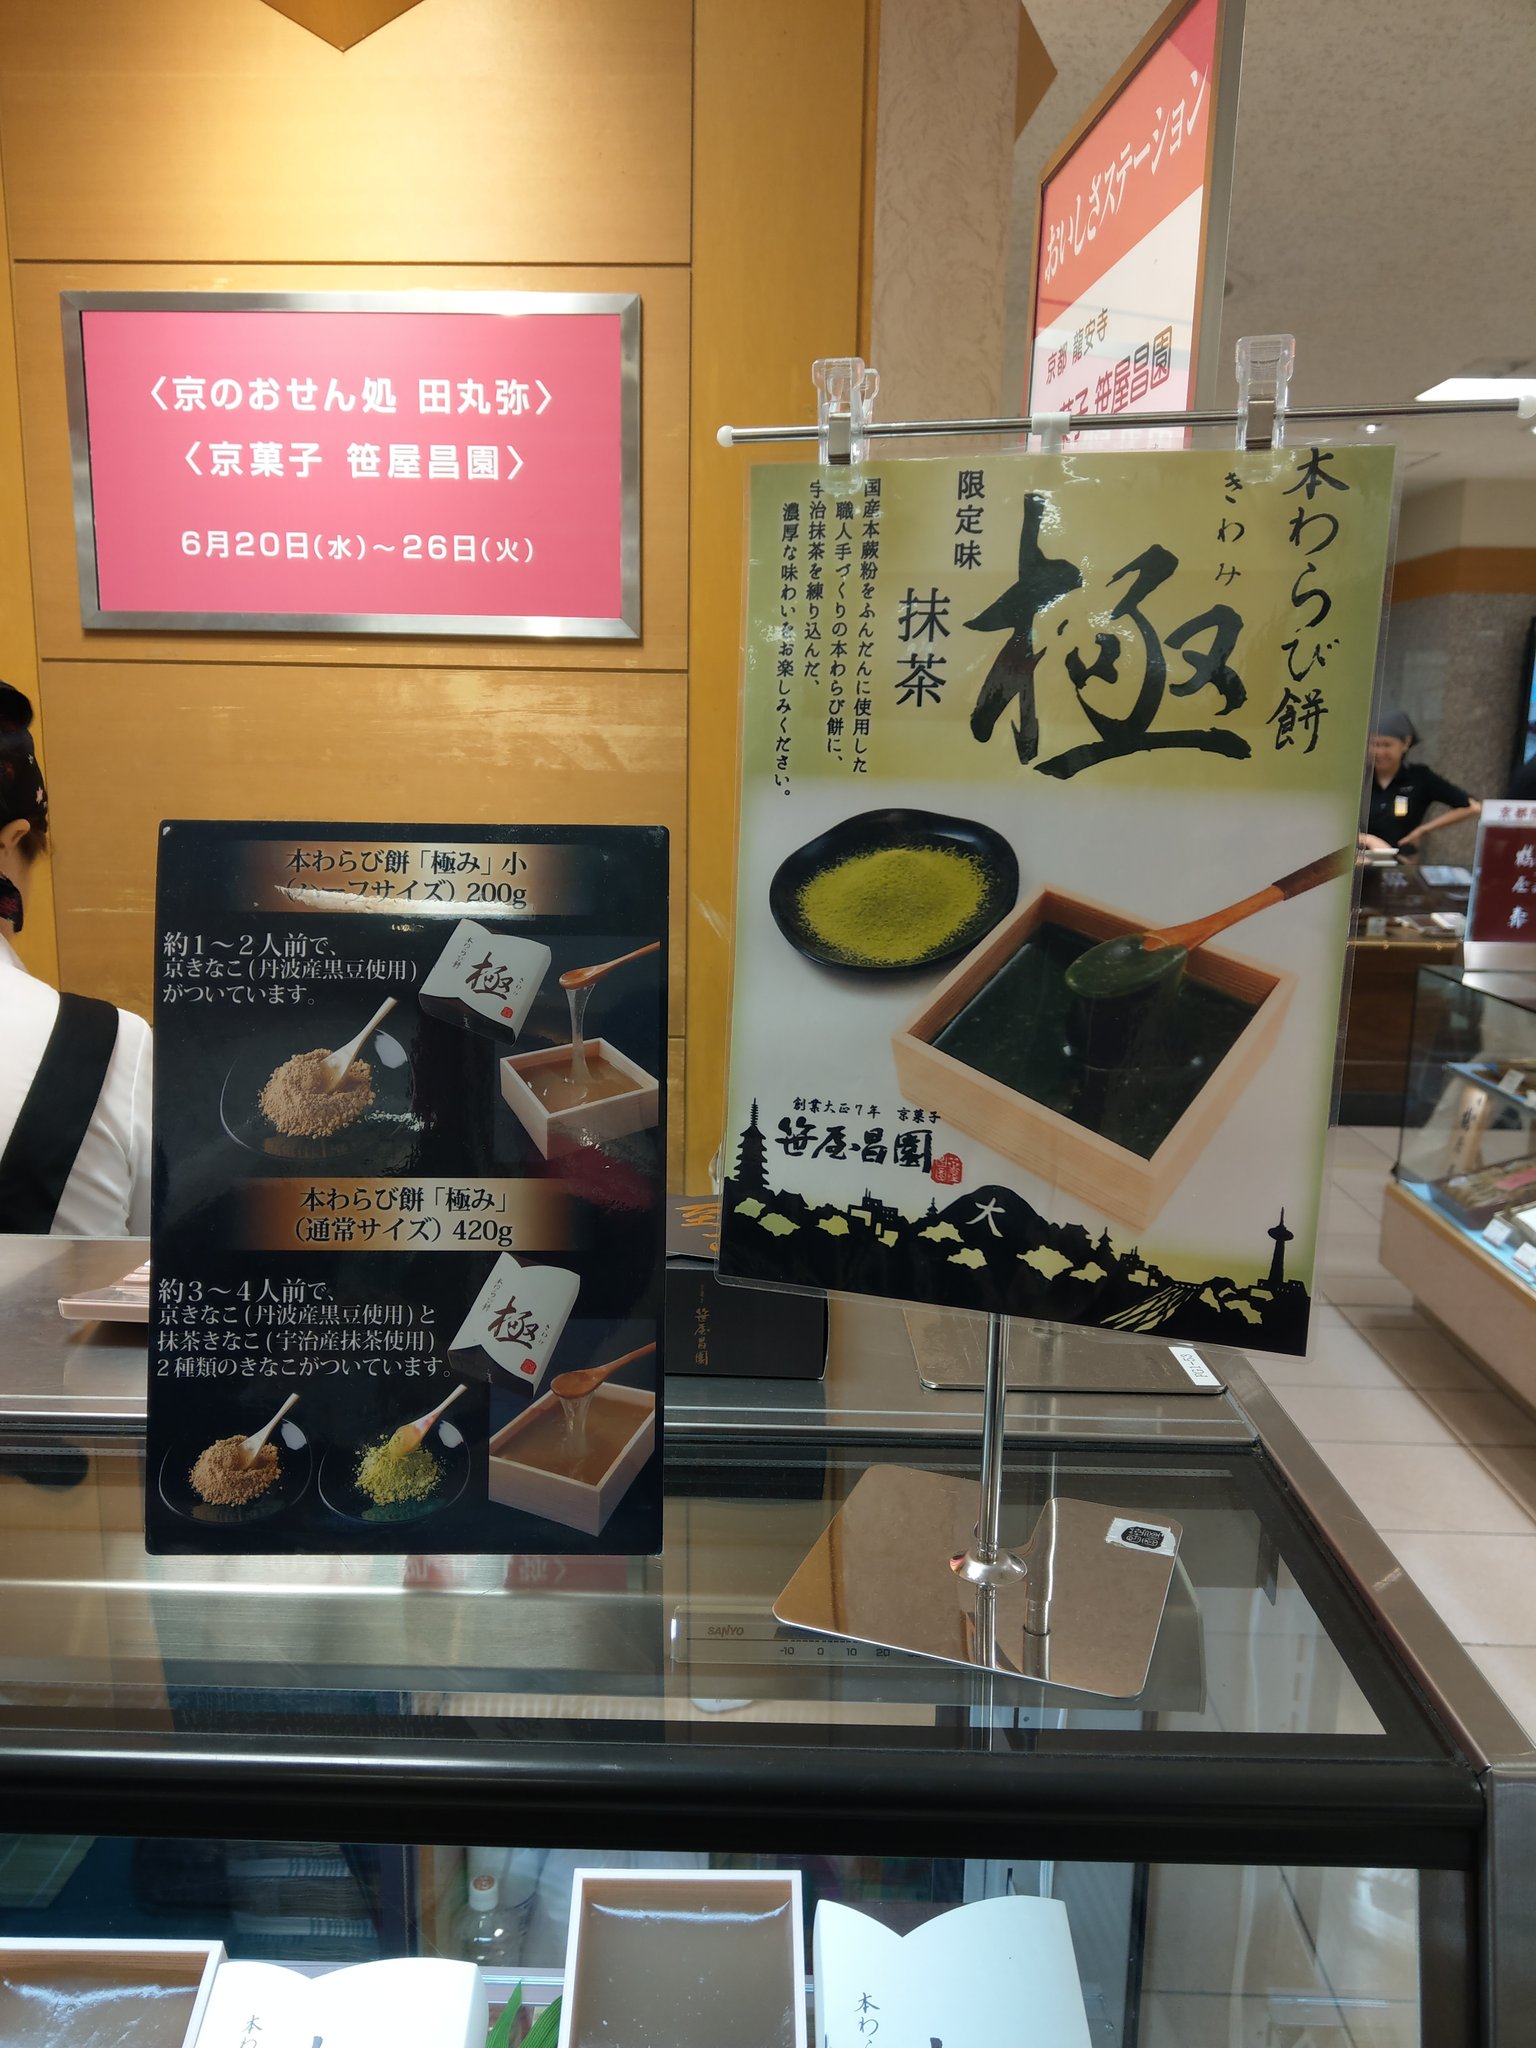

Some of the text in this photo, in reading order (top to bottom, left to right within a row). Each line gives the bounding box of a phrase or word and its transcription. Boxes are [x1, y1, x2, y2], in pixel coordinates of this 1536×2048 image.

[1044, 63, 1209, 285] おいしさステーション
[1046, 308, 1108, 384] 京都 龍安寺
[1095, 325, 1173, 415] 笹屋昌園
[953, 469, 986, 570] 限定味
[1214, 470, 1246, 587] きわみ
[827, 501, 854, 762] 職人手づくりの本わらび餅に、
[852, 478, 882, 773] 国産本蕨粉をふんだんに使用した
[894, 588, 951, 708] 抹茶
[962, 491, 1253, 780] 極
[1265, 447, 1352, 755] 本わらび餅
[163, 984, 315, 1006] がついています。
[465, 951, 514, 1000] 極
[792, 1096, 941, 1124] 創業大正7年 京菓子
[299, 1186, 509, 1213] 本わらび餅「極み」
[488, 1295, 539, 1350] 極
[707, 1626, 744, 1637] SANYO
